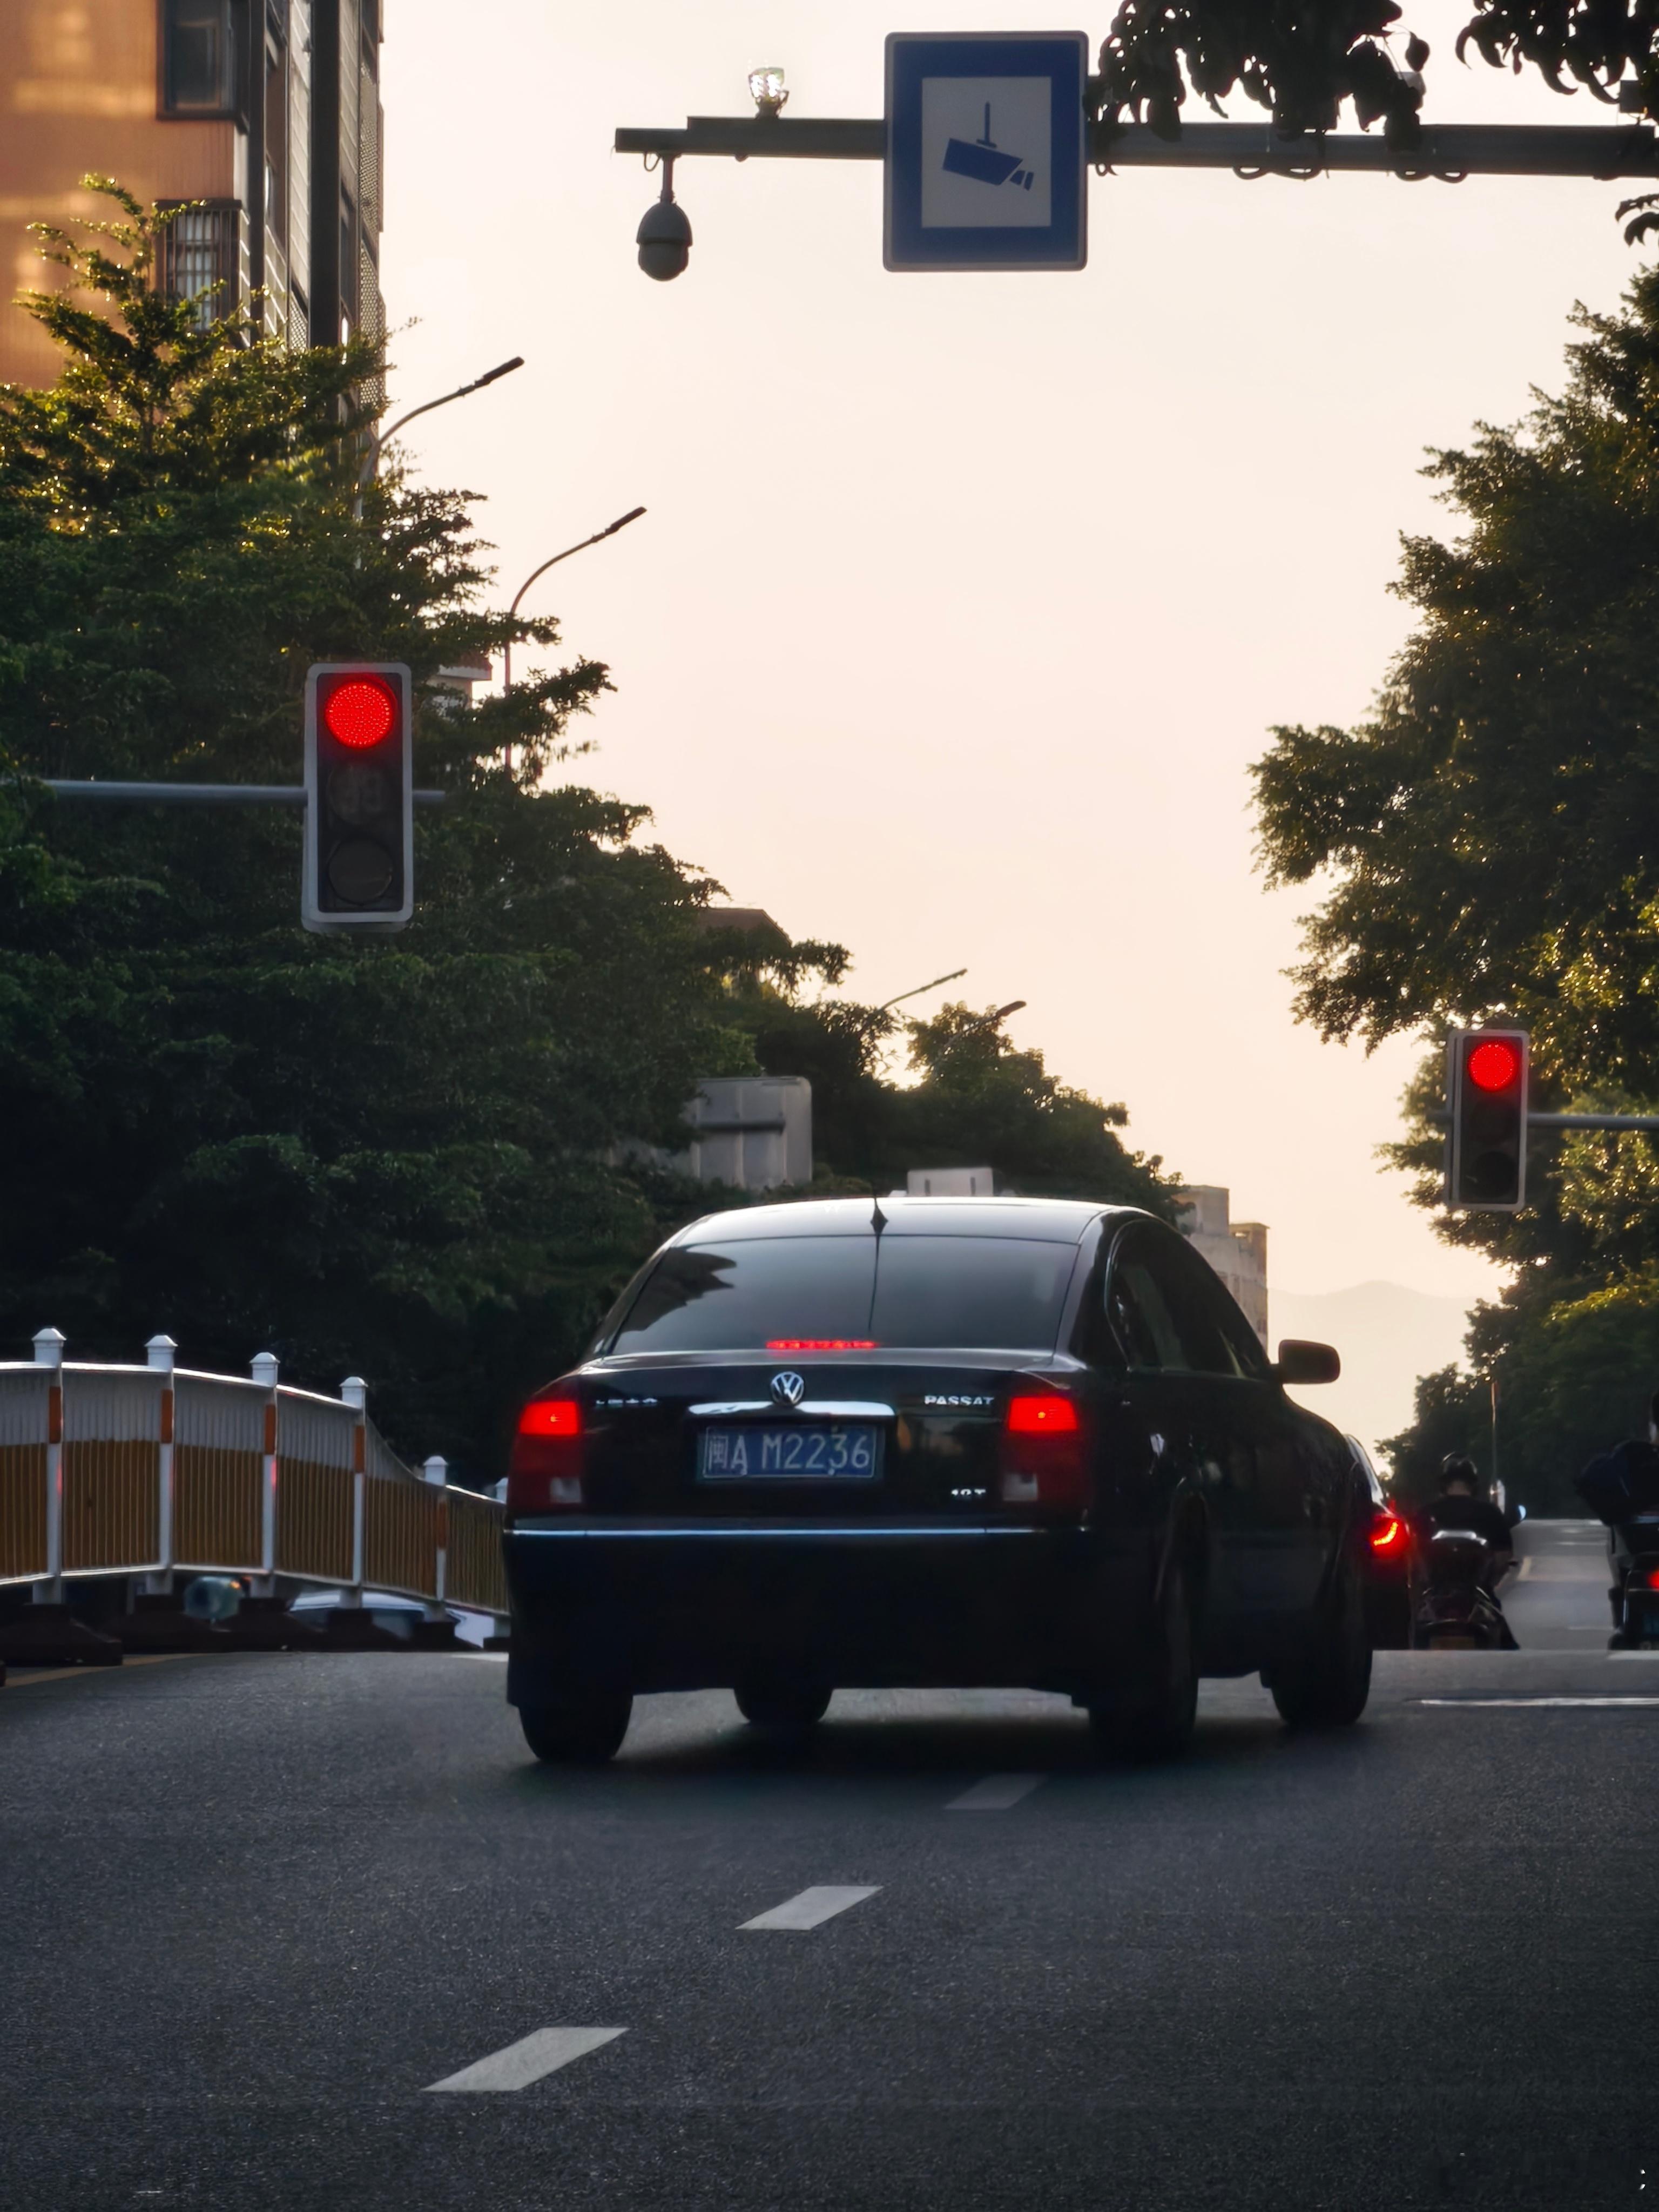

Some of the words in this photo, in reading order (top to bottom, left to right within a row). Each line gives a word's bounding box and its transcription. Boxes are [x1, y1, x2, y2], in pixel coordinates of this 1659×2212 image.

[771, 1371, 804, 1404] VW
[924, 1395, 995, 1405] PASSAT
[708, 1434, 748, 1470] 闽A
[761, 1433, 870, 1469] M2236
